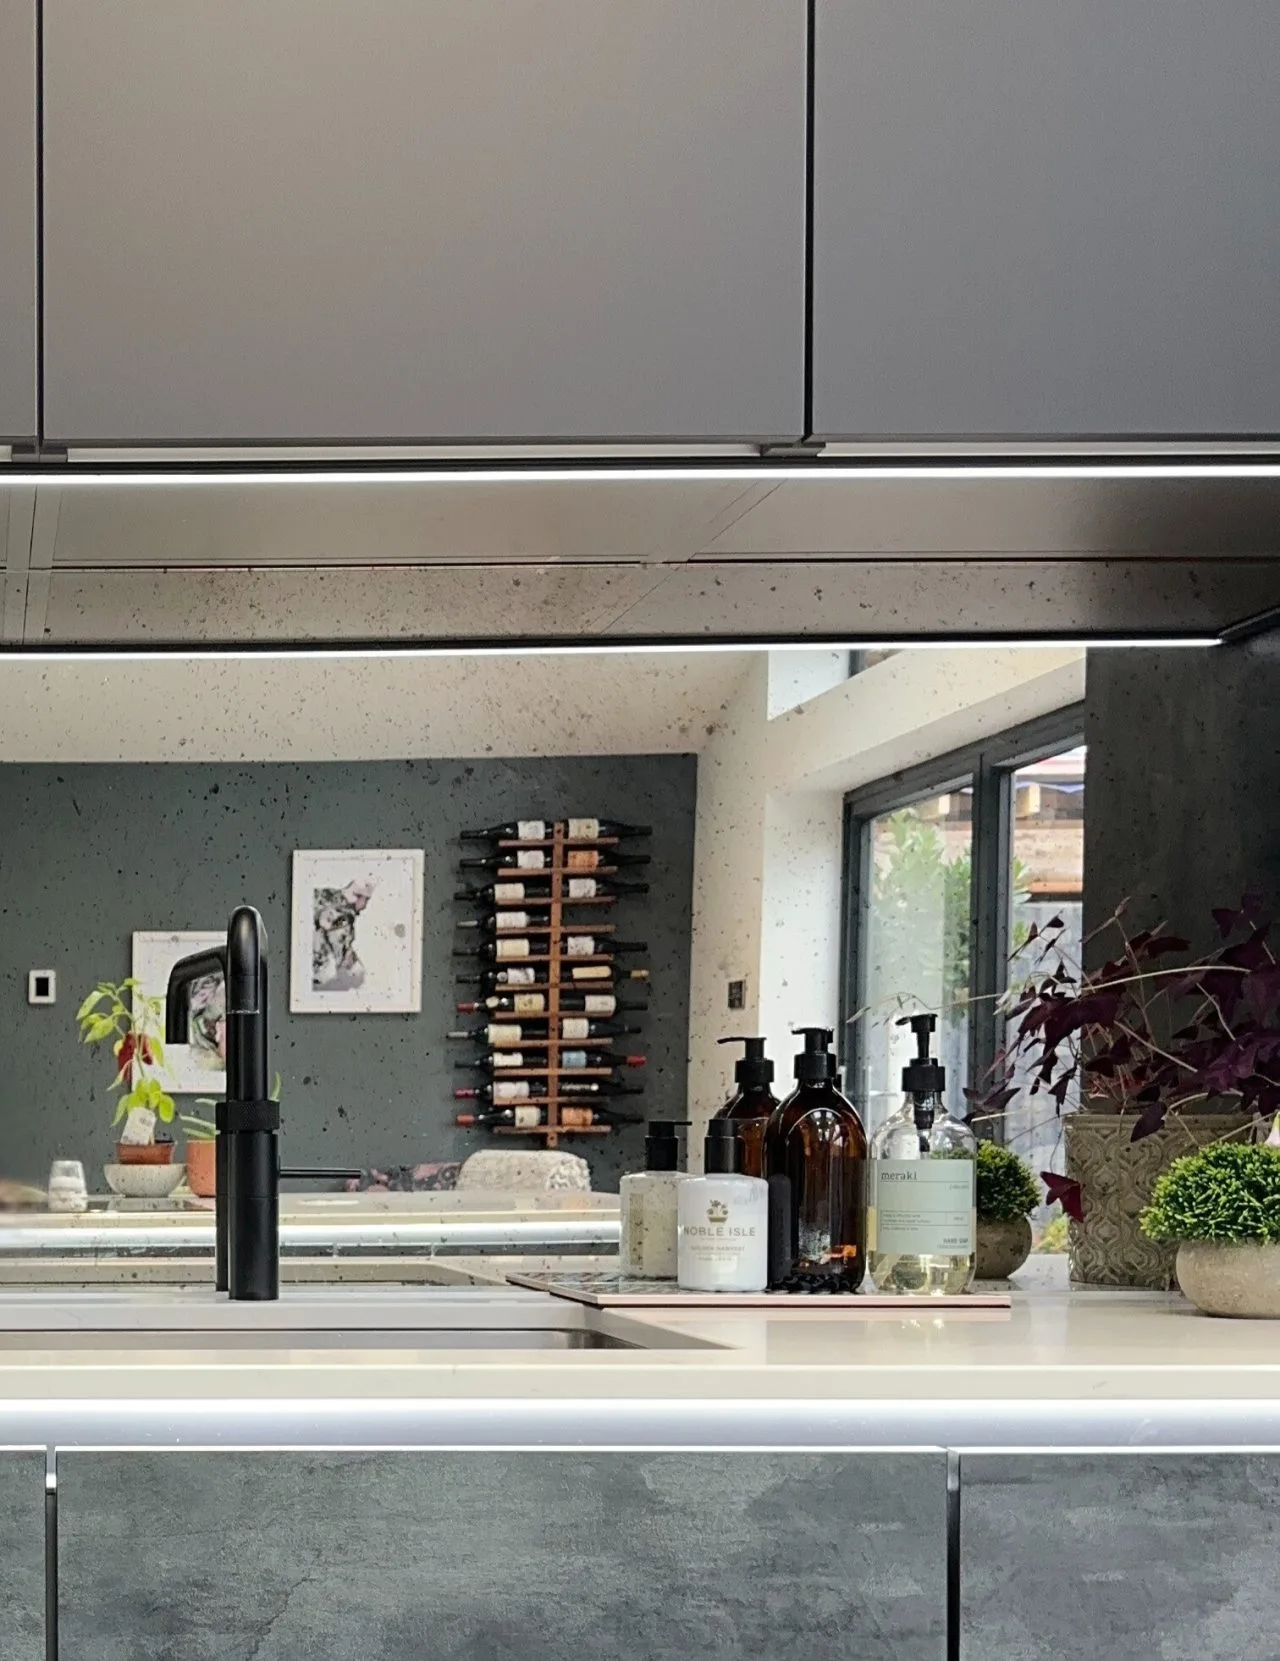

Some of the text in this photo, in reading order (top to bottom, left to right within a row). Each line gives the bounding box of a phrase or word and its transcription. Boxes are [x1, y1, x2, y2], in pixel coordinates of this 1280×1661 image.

[881, 1171, 918, 1181] meraki
[682, 1226, 756, 1237] NOBLE ISLE
